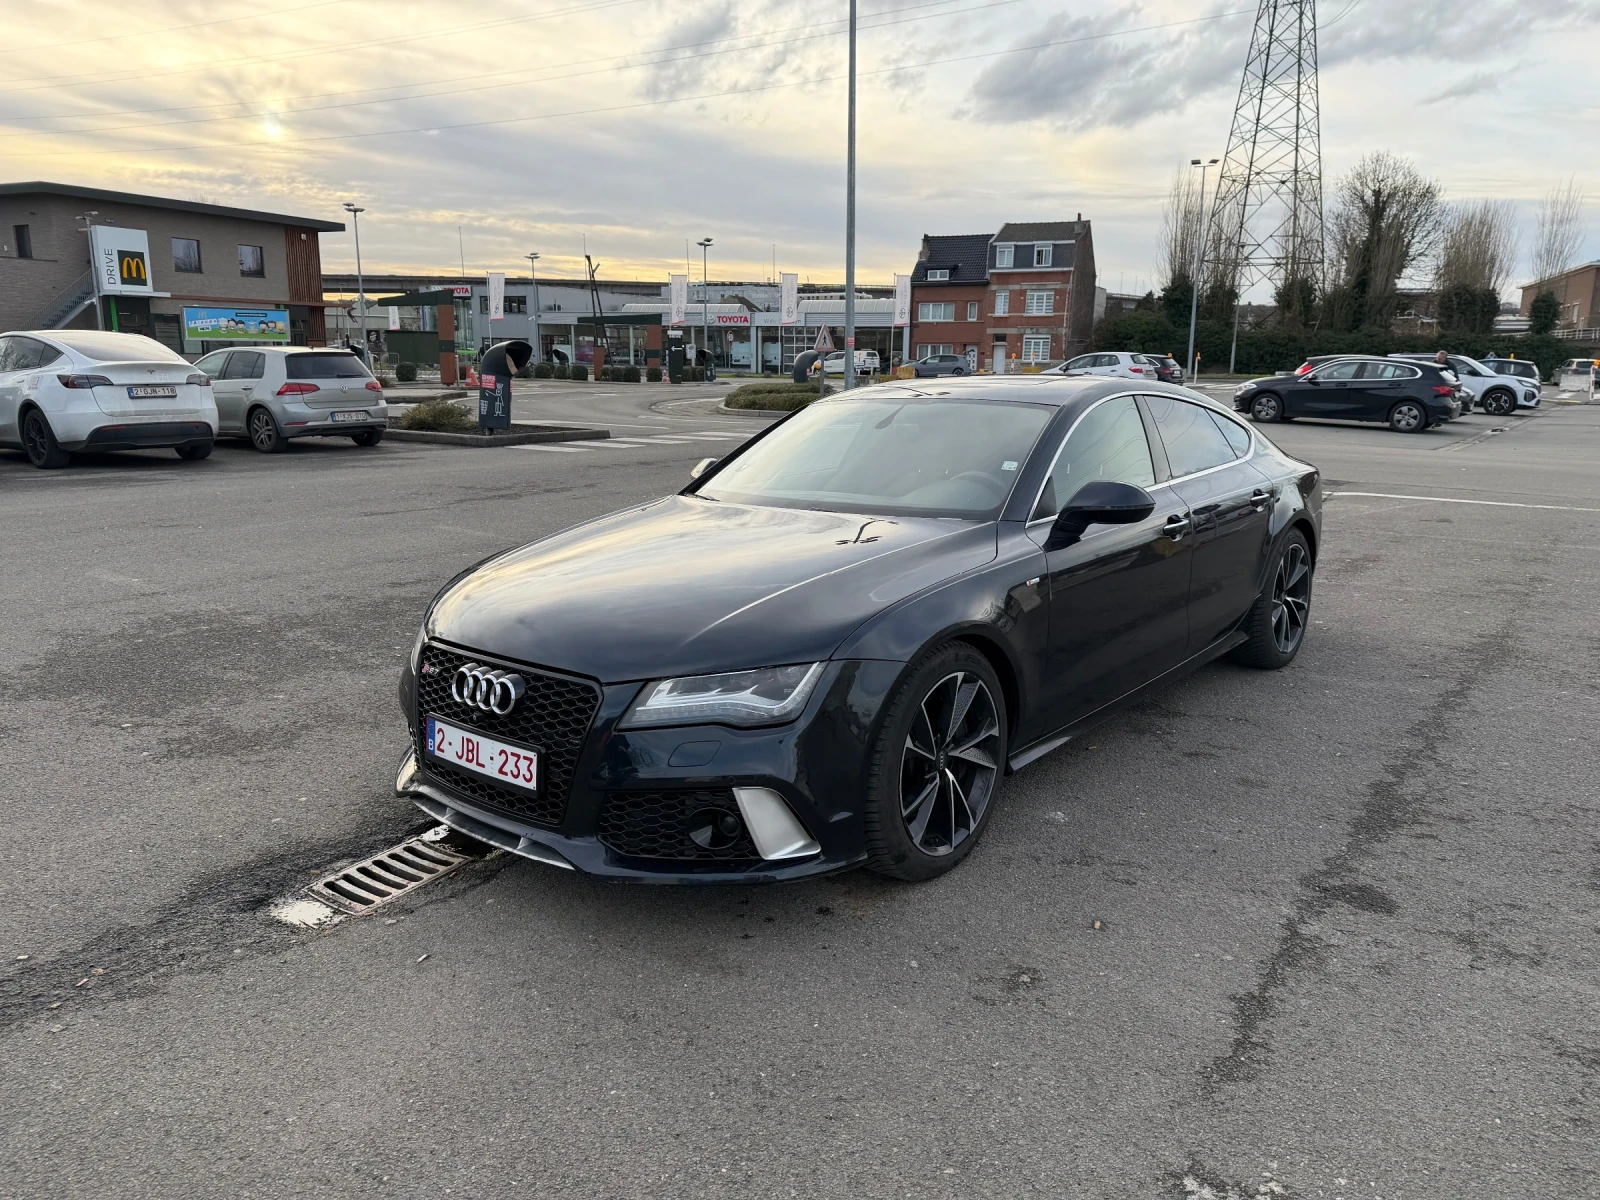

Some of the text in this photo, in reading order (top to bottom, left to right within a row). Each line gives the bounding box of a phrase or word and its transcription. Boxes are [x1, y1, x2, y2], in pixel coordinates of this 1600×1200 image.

[104, 248, 116, 285] DRIVE
[428, 739, 434, 750] B
[437, 728, 534, 783] 2-JBL-233
